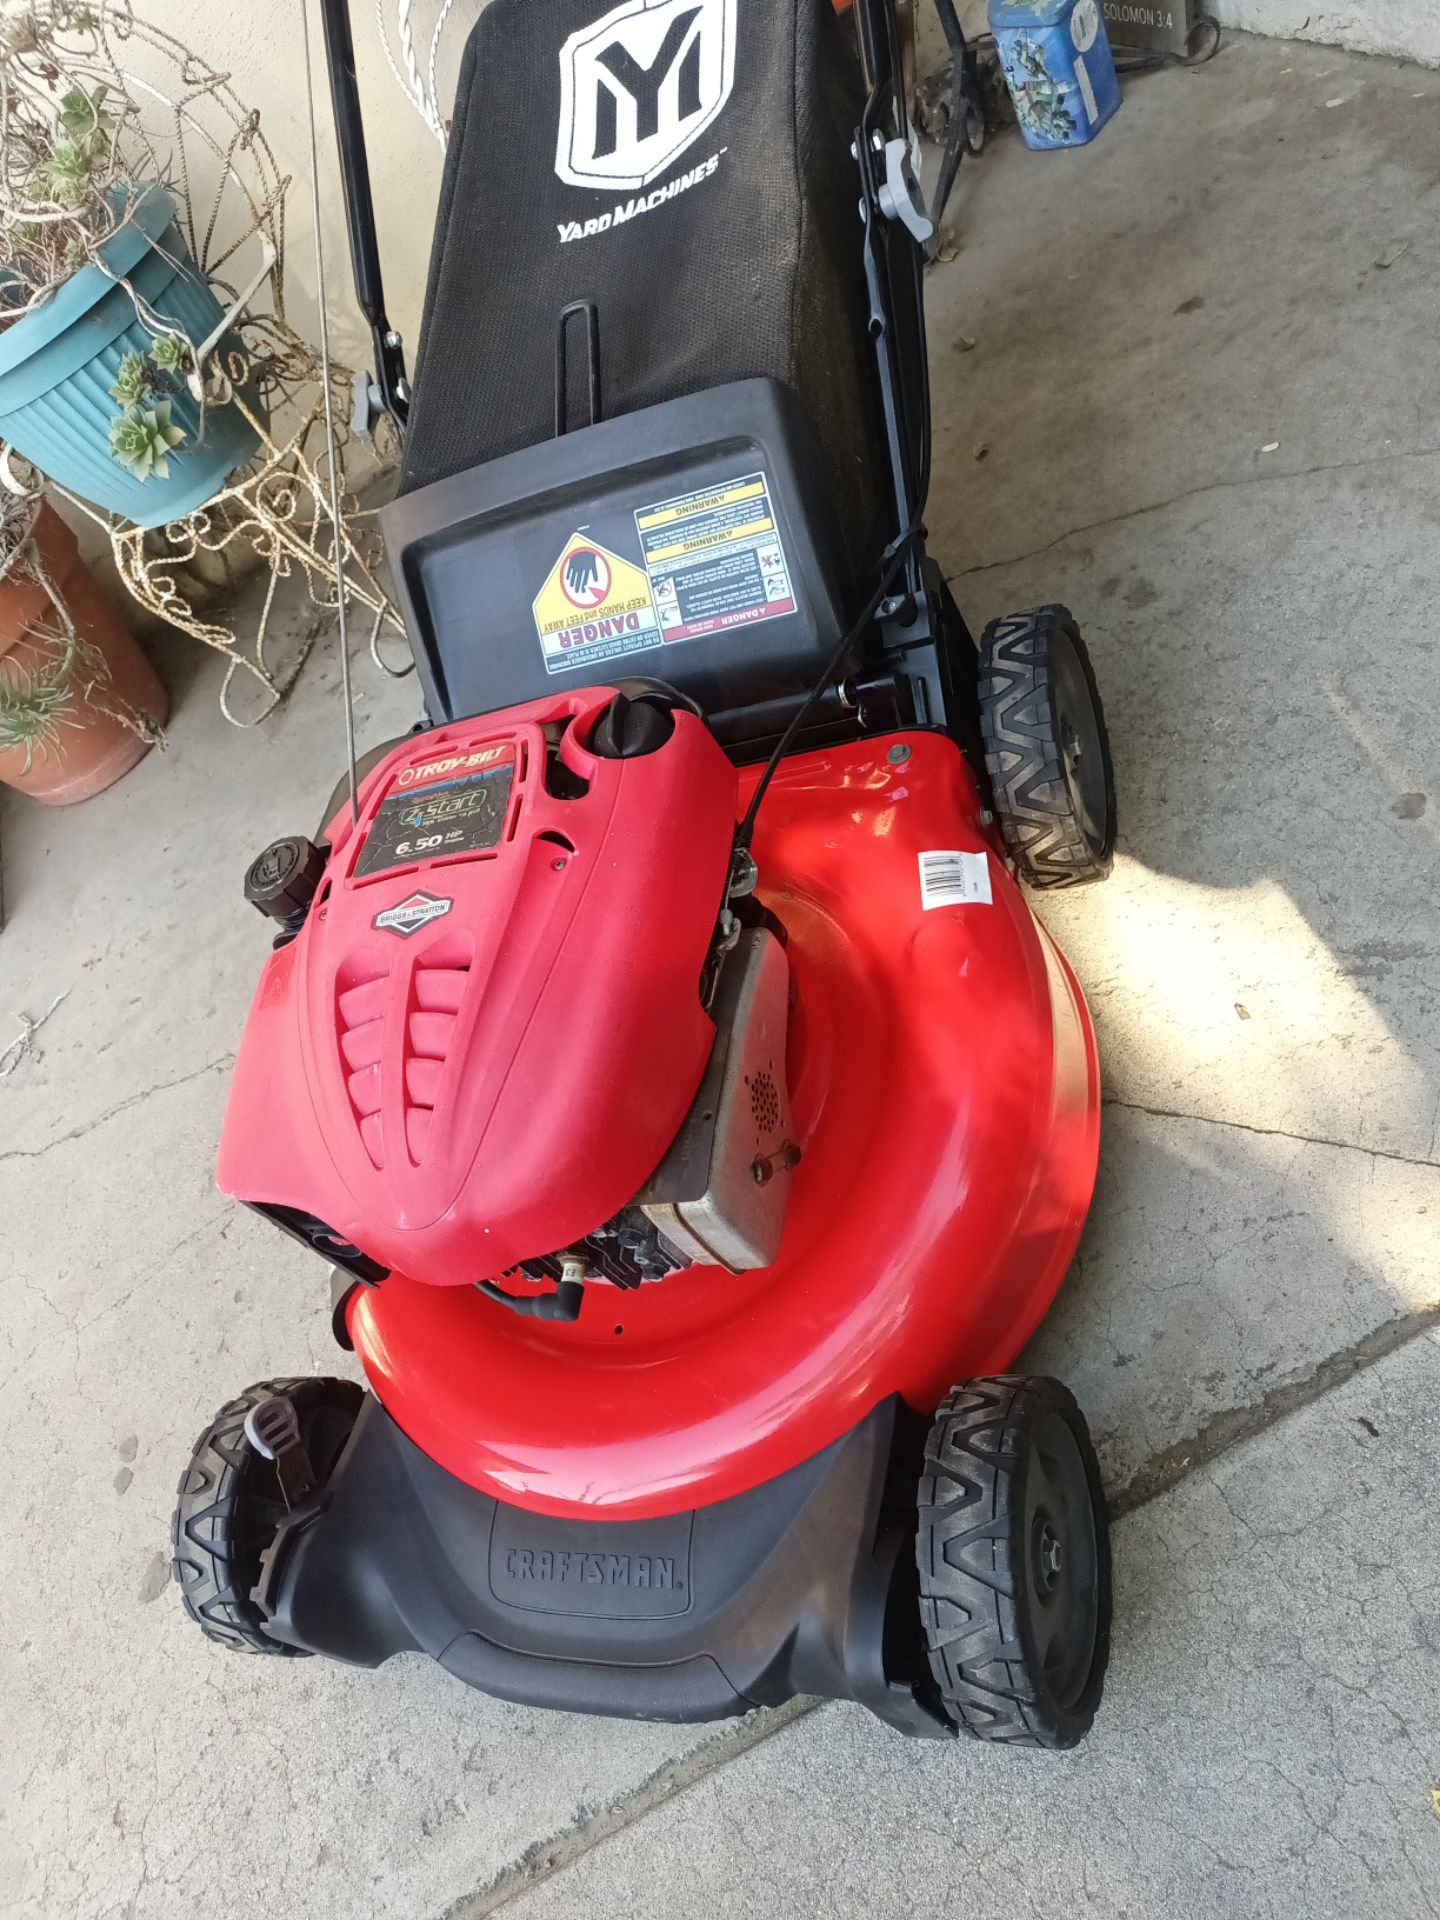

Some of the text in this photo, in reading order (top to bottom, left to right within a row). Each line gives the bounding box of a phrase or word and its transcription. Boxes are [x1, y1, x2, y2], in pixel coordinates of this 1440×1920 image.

[1103, 3, 1154, 26] SOLOMON
[1156, 11, 1173, 30] 3:4
[557, 157, 719, 243] YARD MACHINES
[675, 497, 720, 515] WARNING
[682, 532, 728, 550] WARNING
[543, 596, 647, 632] KEEP HANDS and FEET AWAY
[720, 609, 759, 626] DANGER
[557, 612, 640, 648] DANGER
[415, 745, 508, 780] TROY-BILT
[395, 834, 443, 854] 6.50
[445, 829, 463, 839] HP
[380, 911, 407, 923] BRIGGS
[411, 903, 446, 917] STRATTON
[505, 1548, 675, 1590] CRAFTSMAN
